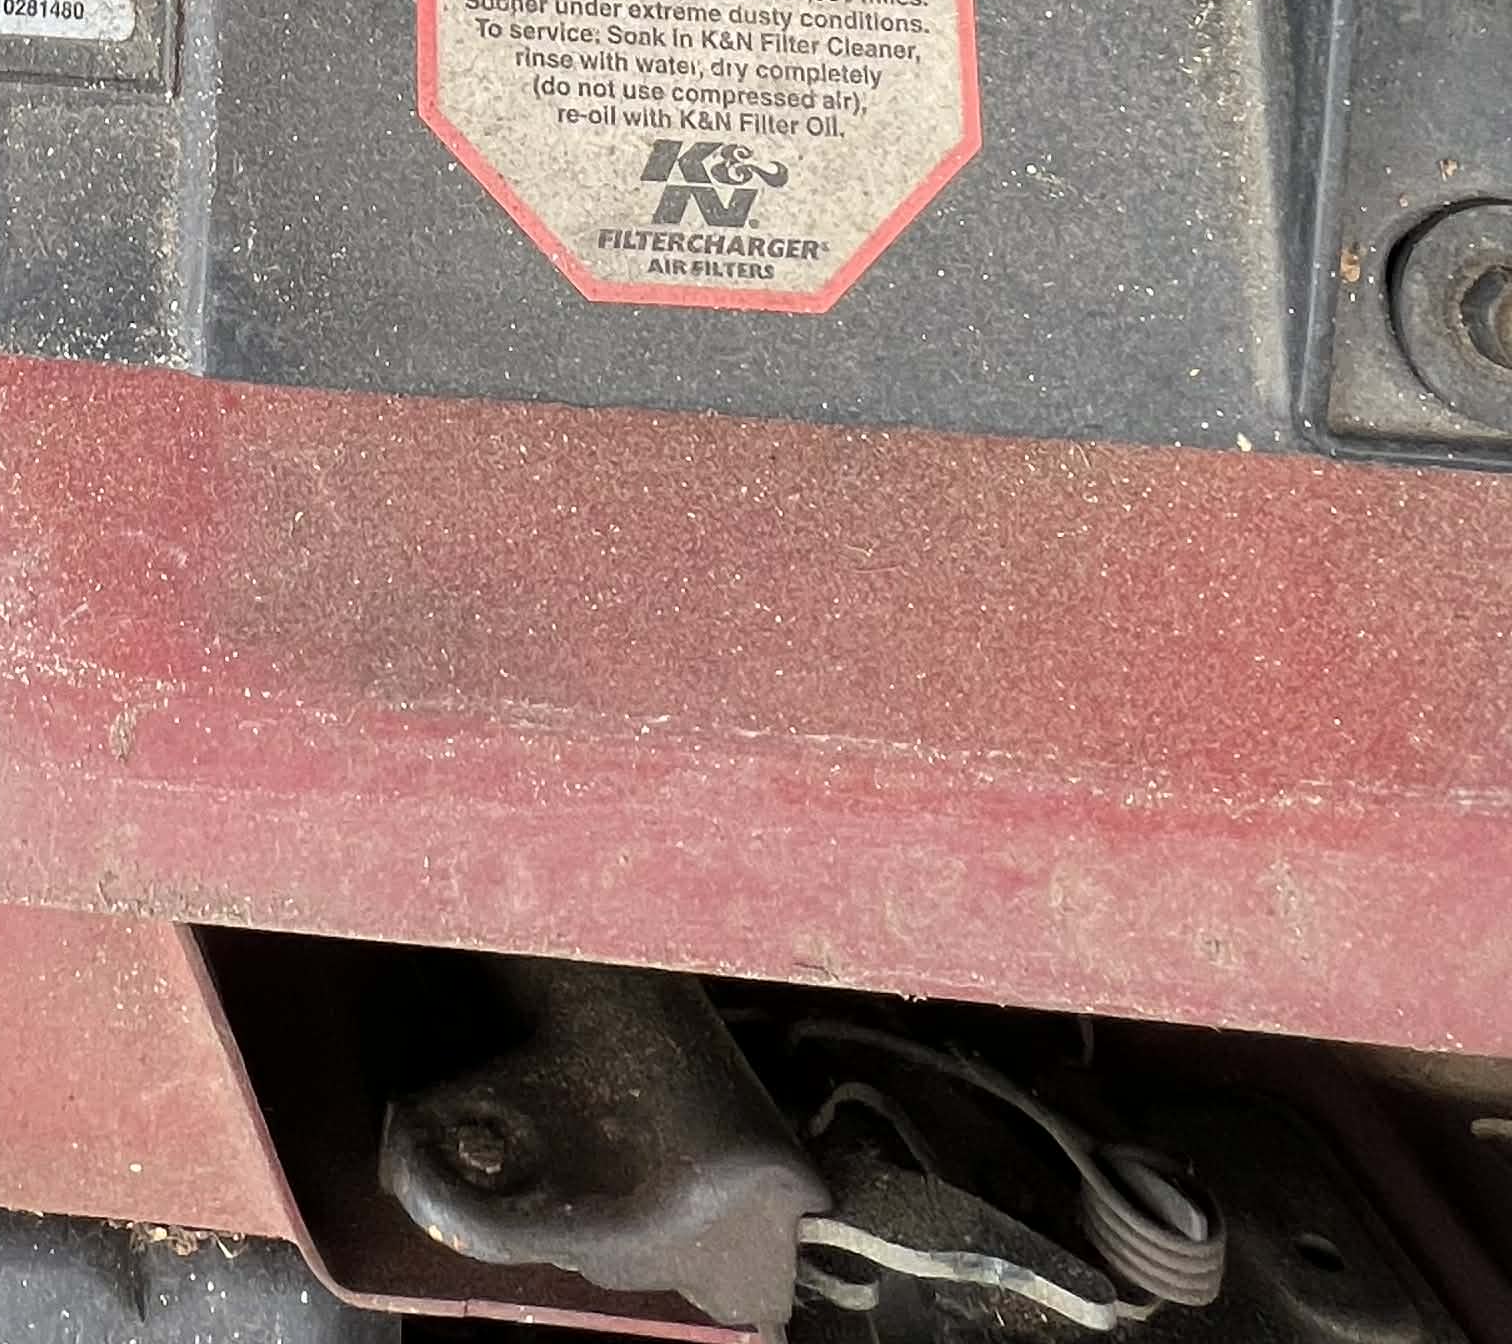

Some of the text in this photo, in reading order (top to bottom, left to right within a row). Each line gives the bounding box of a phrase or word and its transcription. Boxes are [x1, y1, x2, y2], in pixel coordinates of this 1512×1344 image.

[627, 3, 722, 23] extreme
[728, 4, 793, 31] dusty
[799, 11, 931, 34] conditions.
[532, 73, 816, 110] (do not use compressed
[646, 258, 775, 280] AIR FILTERS
